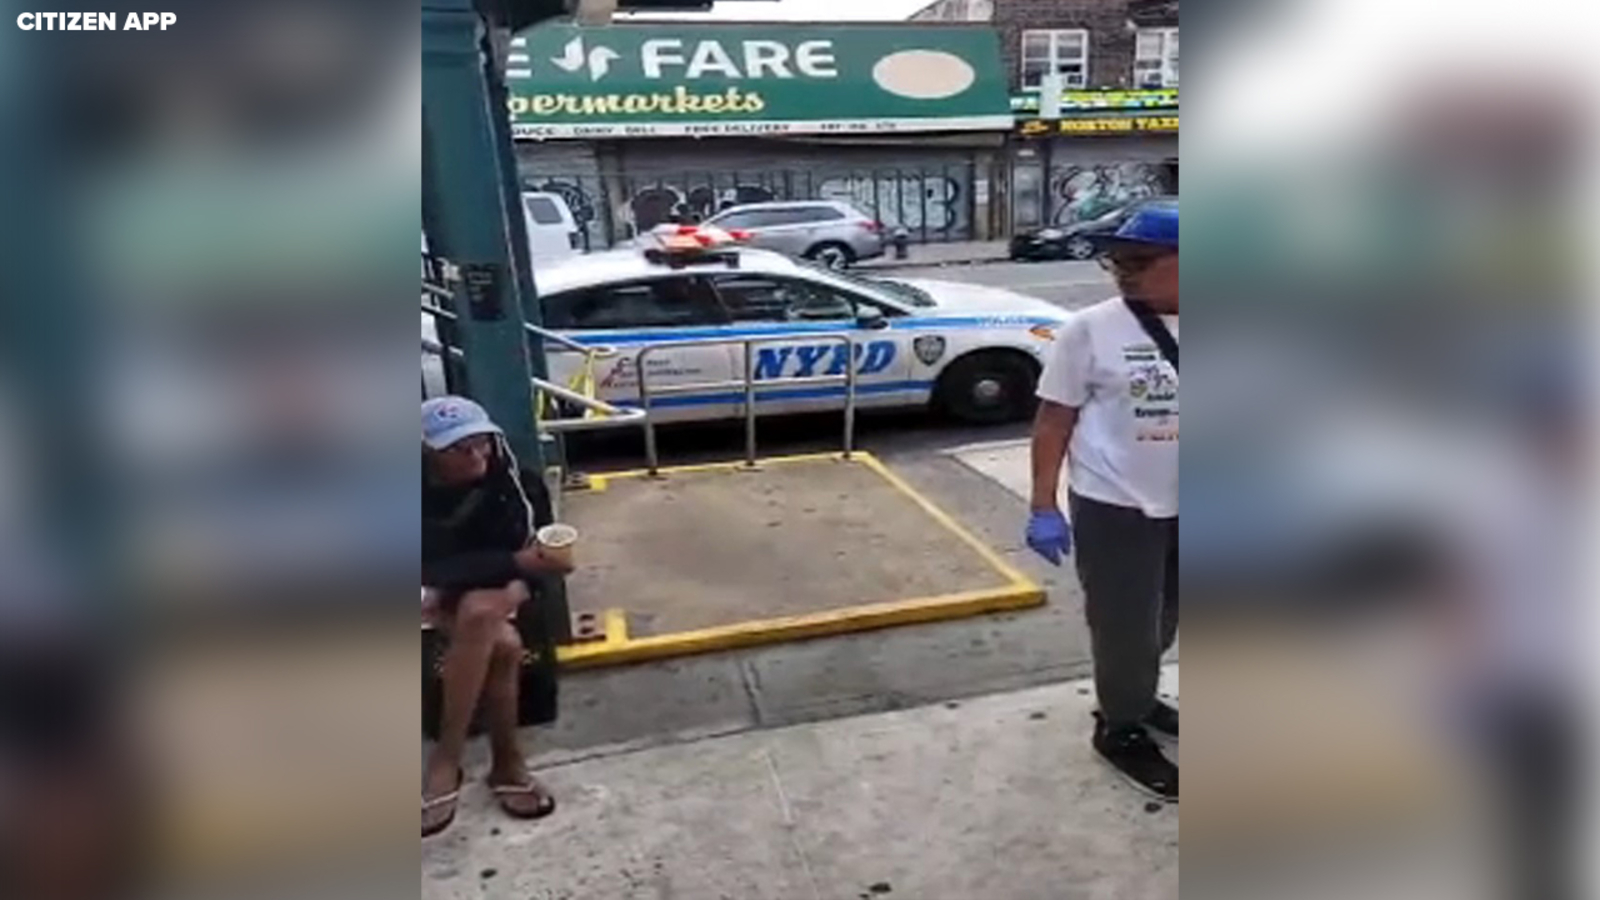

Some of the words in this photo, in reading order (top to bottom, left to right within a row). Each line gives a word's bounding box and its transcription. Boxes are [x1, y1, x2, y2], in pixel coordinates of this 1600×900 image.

[641, 38, 838, 79] FARE
[507, 85, 765, 122] permarkets
[724, 123, 791, 132] DELIVERY
[753, 340, 897, 381] NYPD
